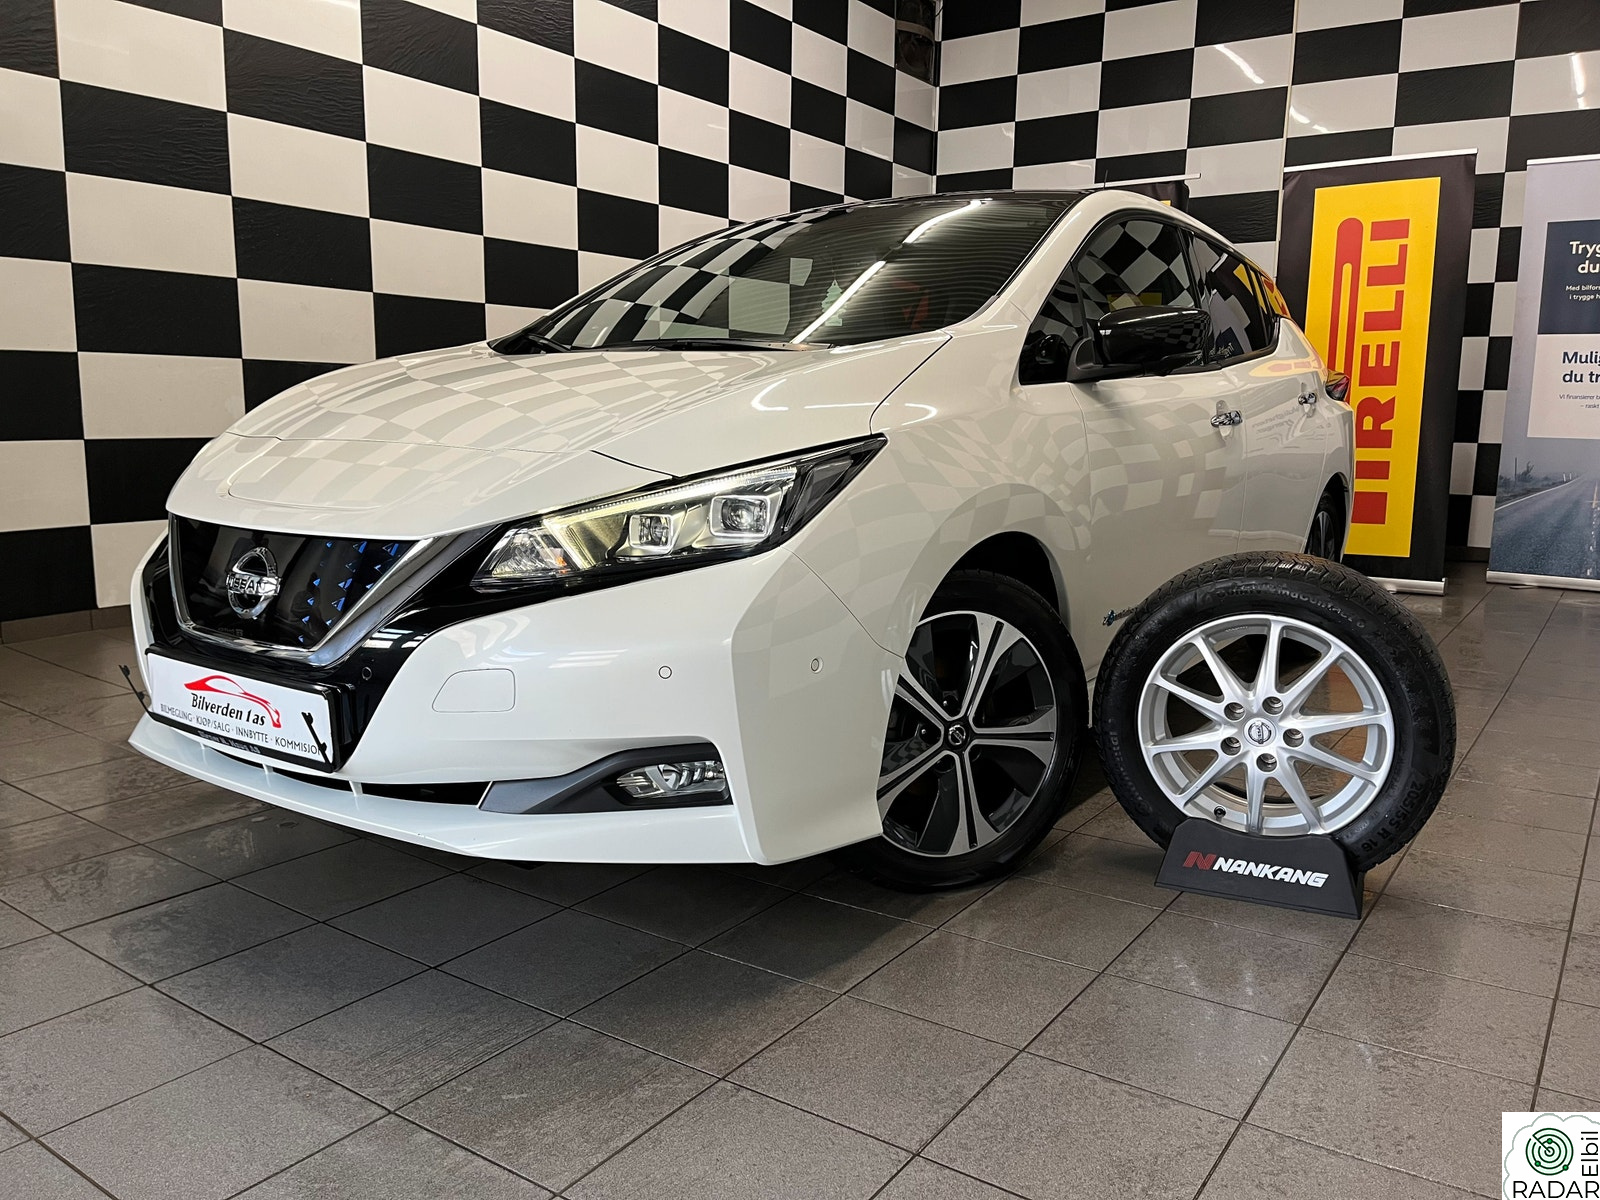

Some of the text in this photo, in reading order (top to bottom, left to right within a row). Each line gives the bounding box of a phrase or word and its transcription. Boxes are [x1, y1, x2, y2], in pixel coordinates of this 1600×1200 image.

[1578, 260, 1600, 273] du
[1327, 217, 1410, 524] PIRELLI
[1562, 370, 1583, 383] du
[160, 703, 193, 722] BILMEGLING
[196, 715, 230, 733] KJØP/SALG
[236, 727, 269, 743] INNBYTTE
[191, 693, 243, 720] Bilverden
[252, 713, 266, 726] as
[1213, 857, 1329, 888] NANKANG
